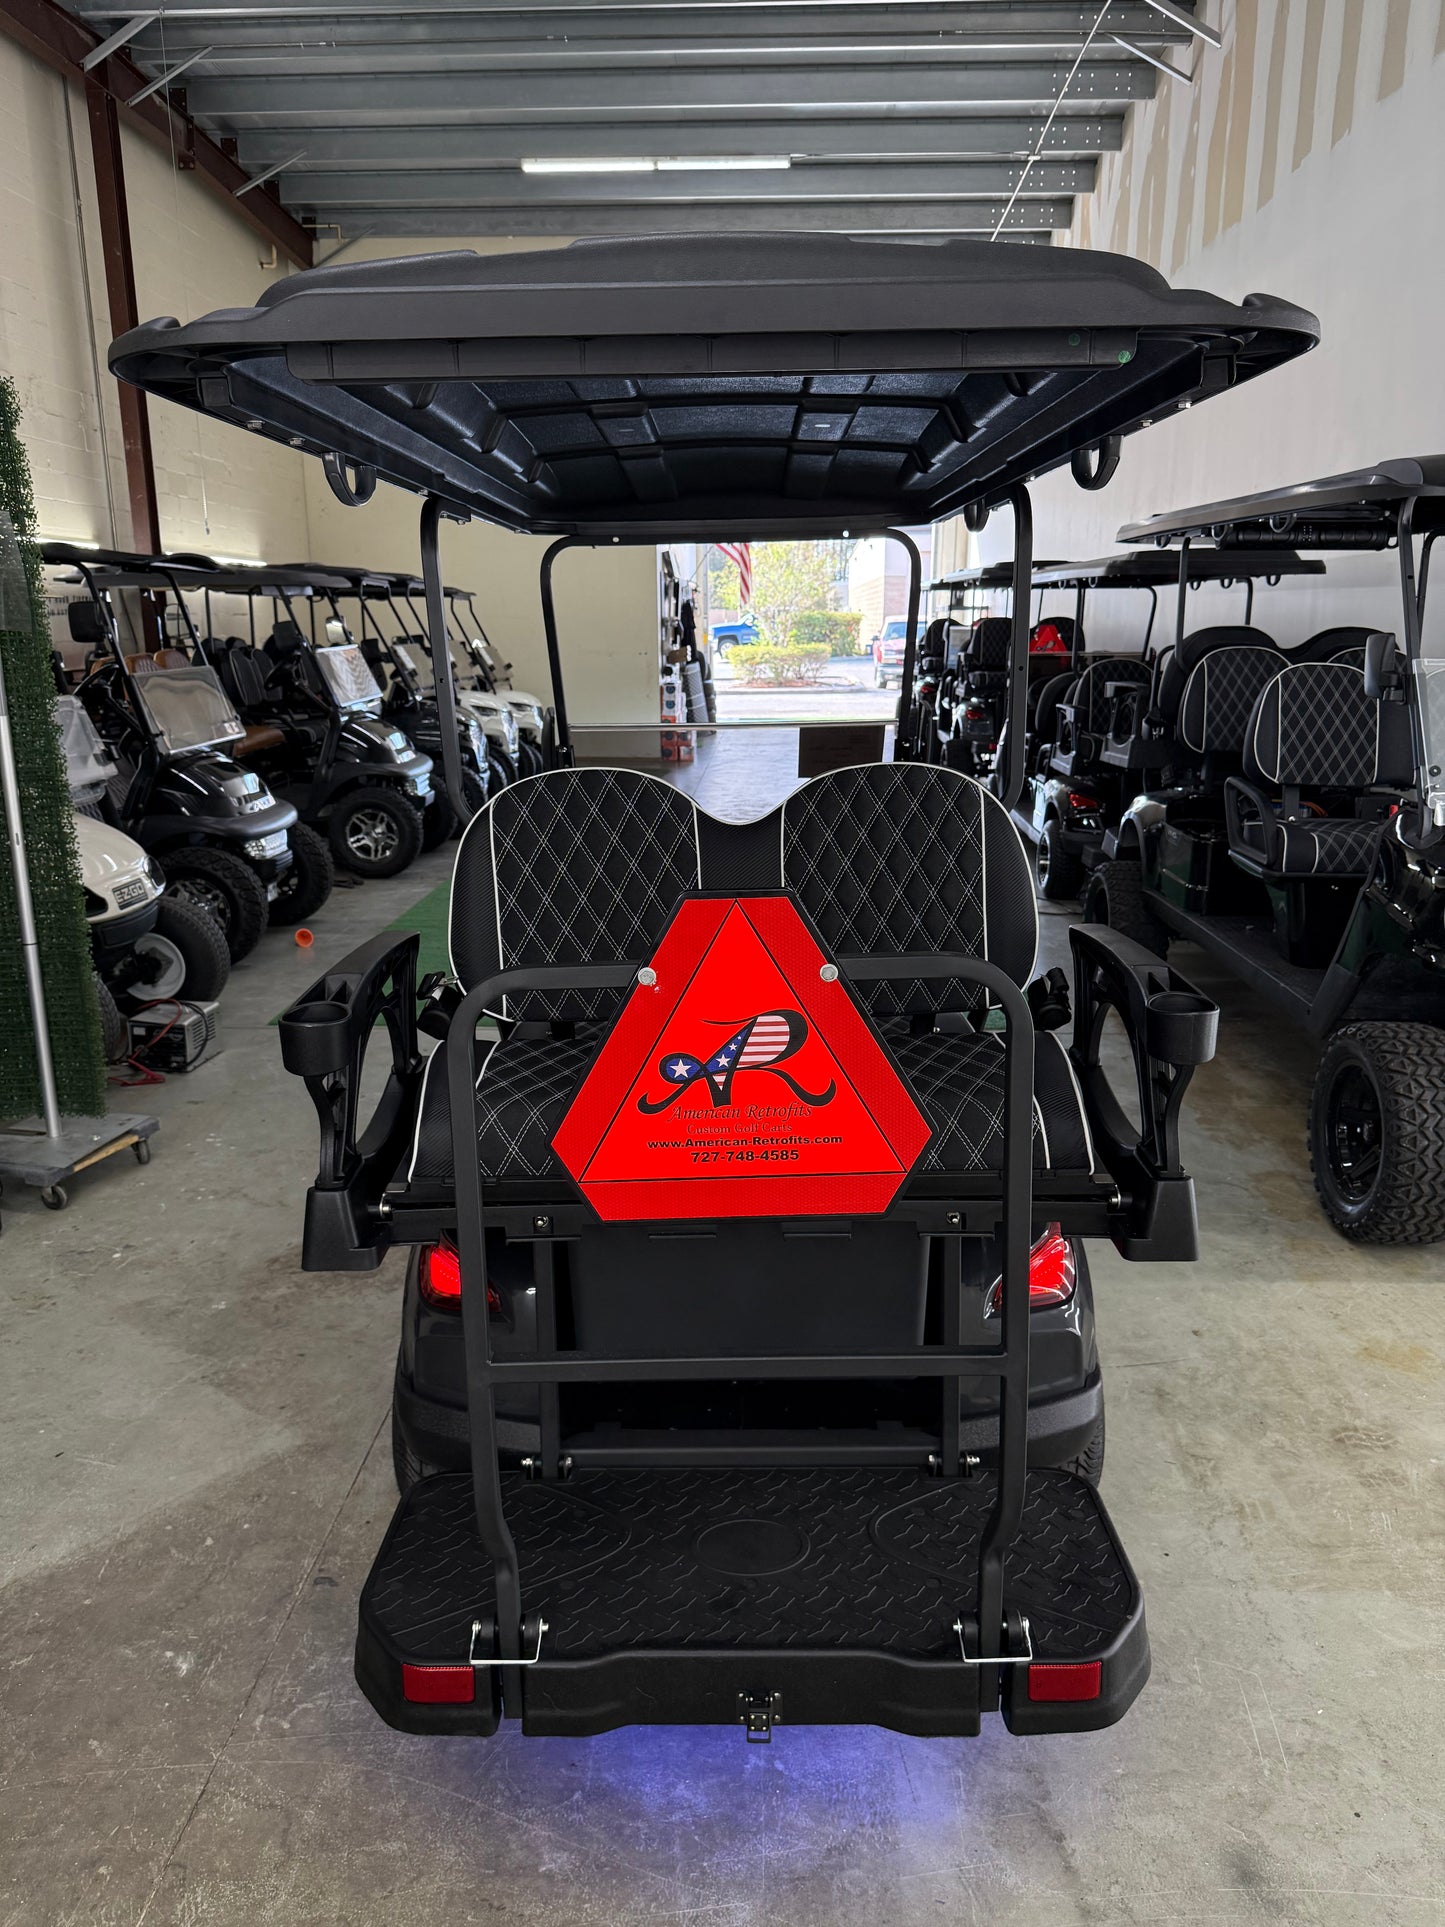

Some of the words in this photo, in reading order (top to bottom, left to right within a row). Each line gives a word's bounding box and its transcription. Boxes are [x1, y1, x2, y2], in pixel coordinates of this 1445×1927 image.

[668, 1104, 740, 1122] American
[745, 1101, 813, 1122] Retrofits
[687, 1123, 731, 1135] Custom
[734, 1122, 760, 1133] Golf
[761, 1121, 793, 1133] Carts
[647, 1135, 843, 1149] www.American-Retrofits.com
[690, 1149, 800, 1163] 727-748-4585
